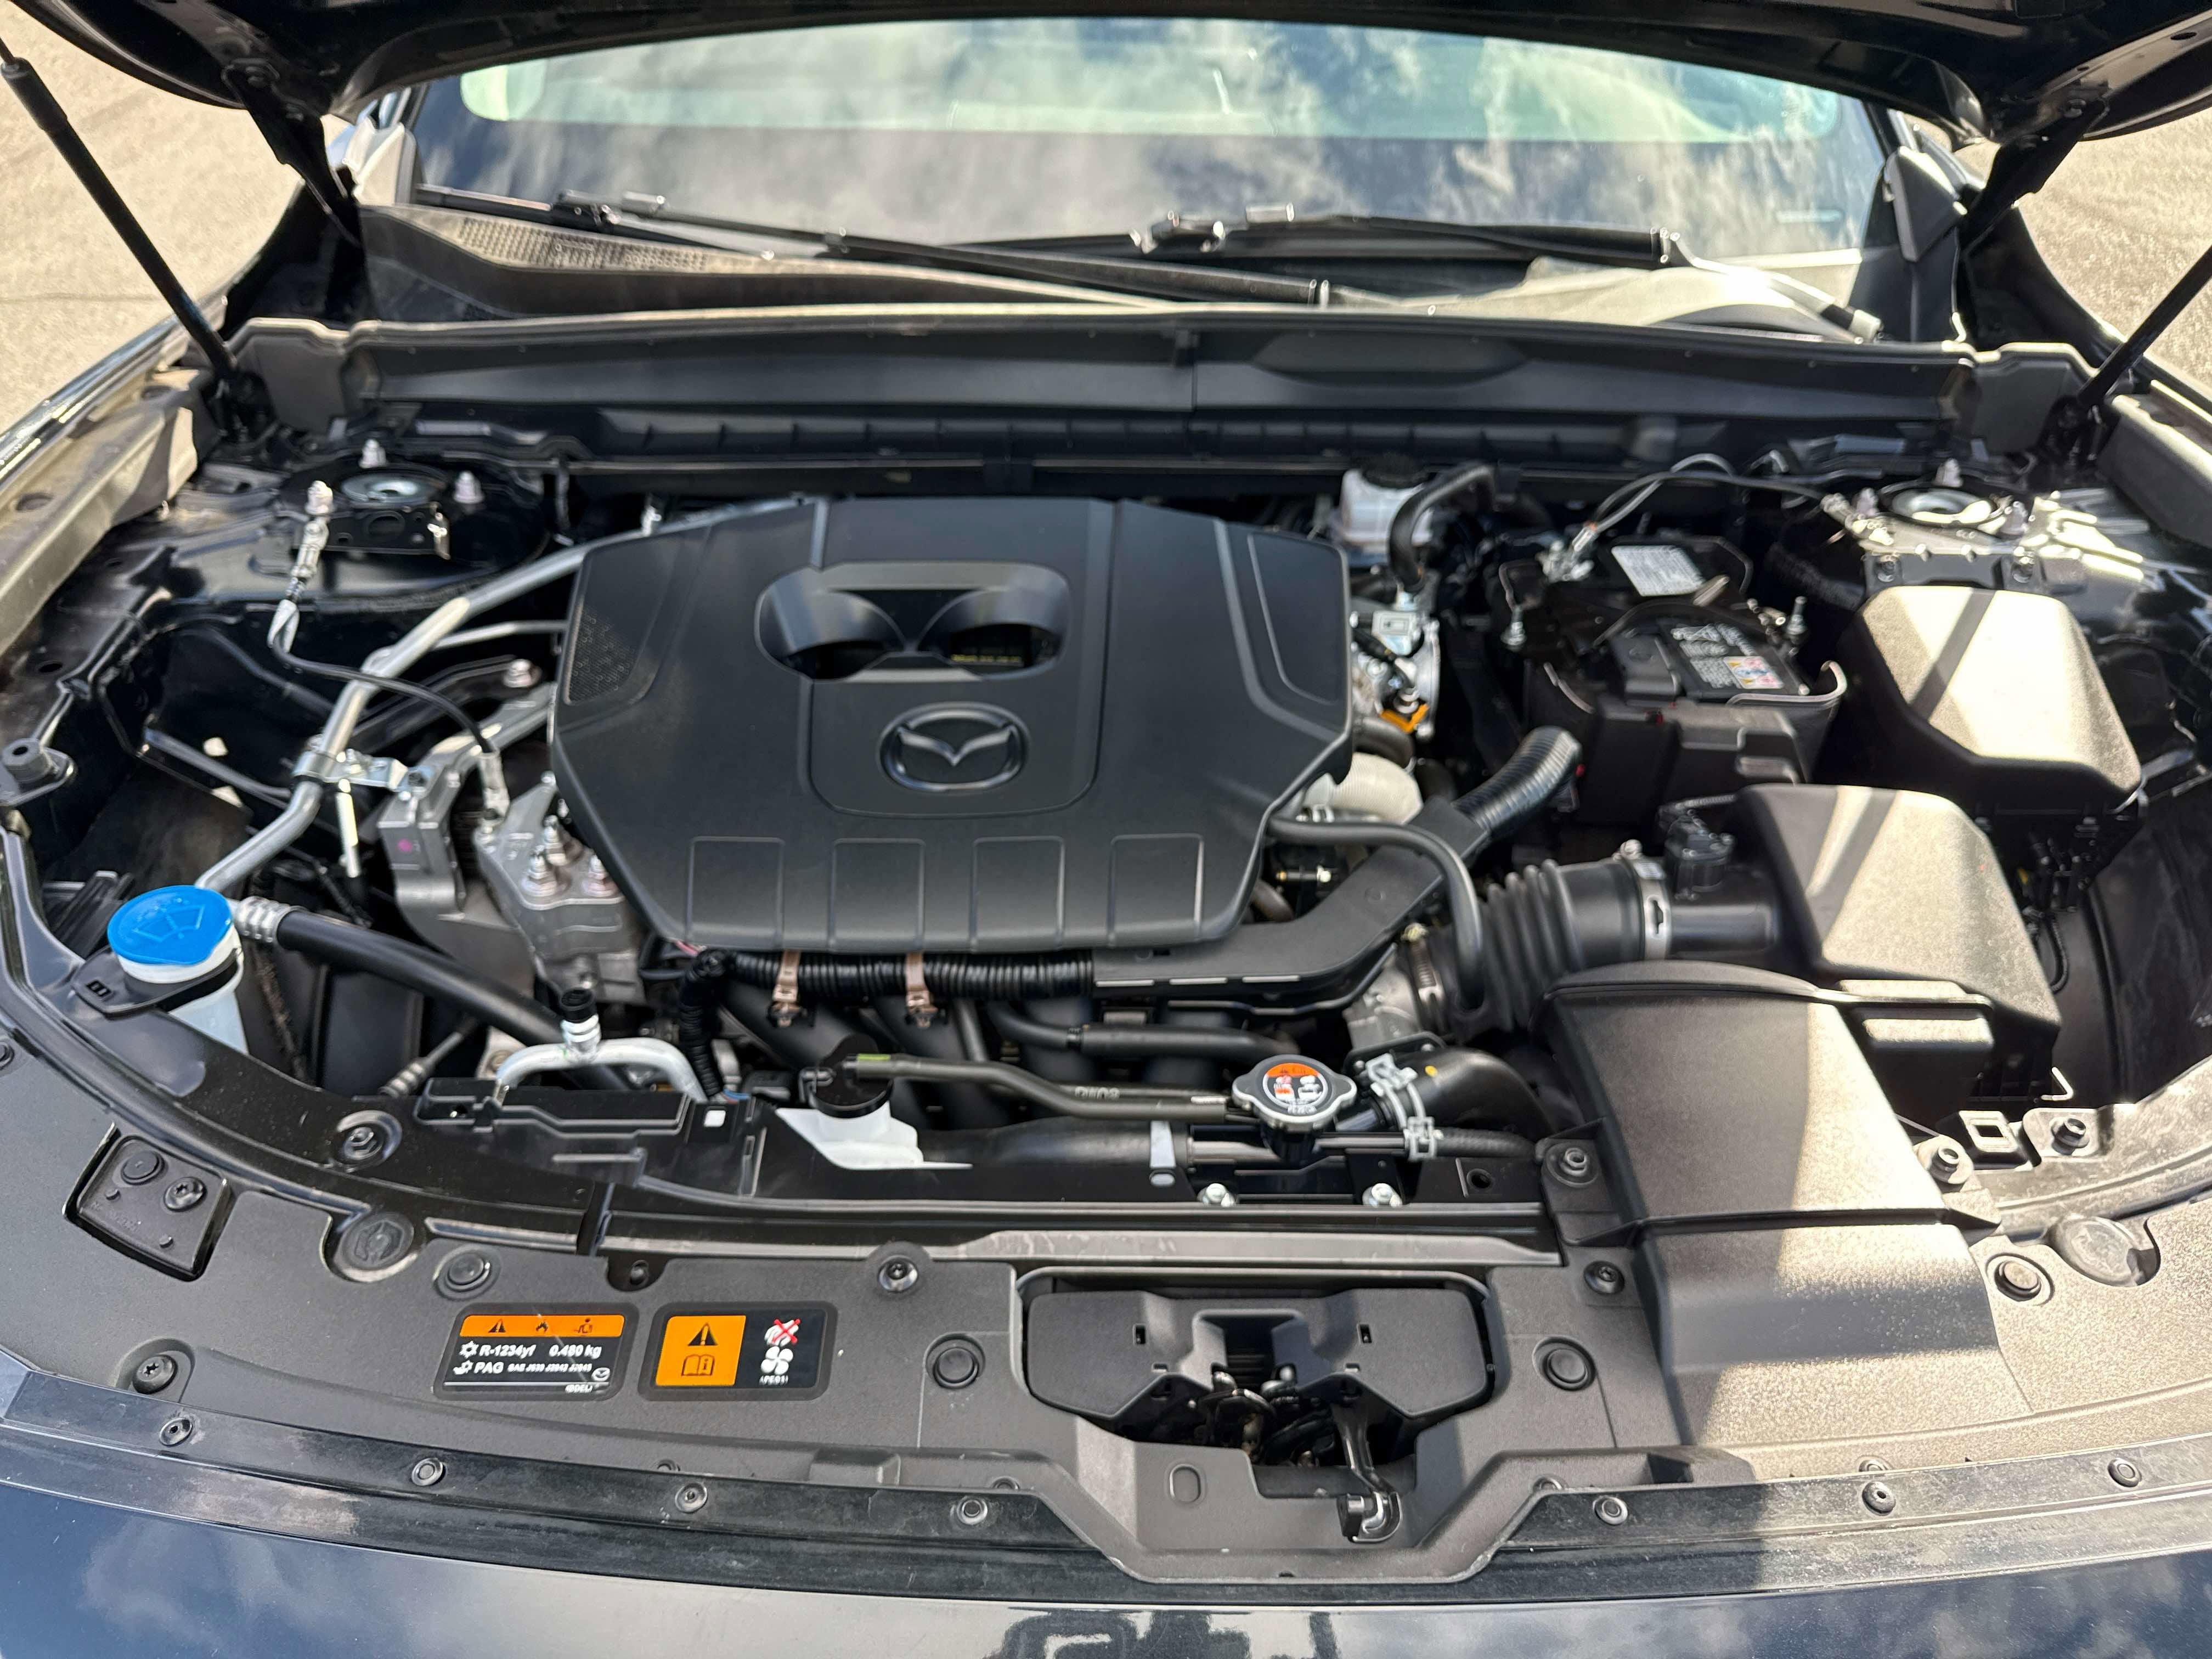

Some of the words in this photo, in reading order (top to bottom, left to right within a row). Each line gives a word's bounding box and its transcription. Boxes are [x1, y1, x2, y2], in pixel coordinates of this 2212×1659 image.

[479, 1344, 537, 1359] R-1234yf
[584, 1344, 602, 1359] kg
[474, 1362, 504, 1374] PAG
